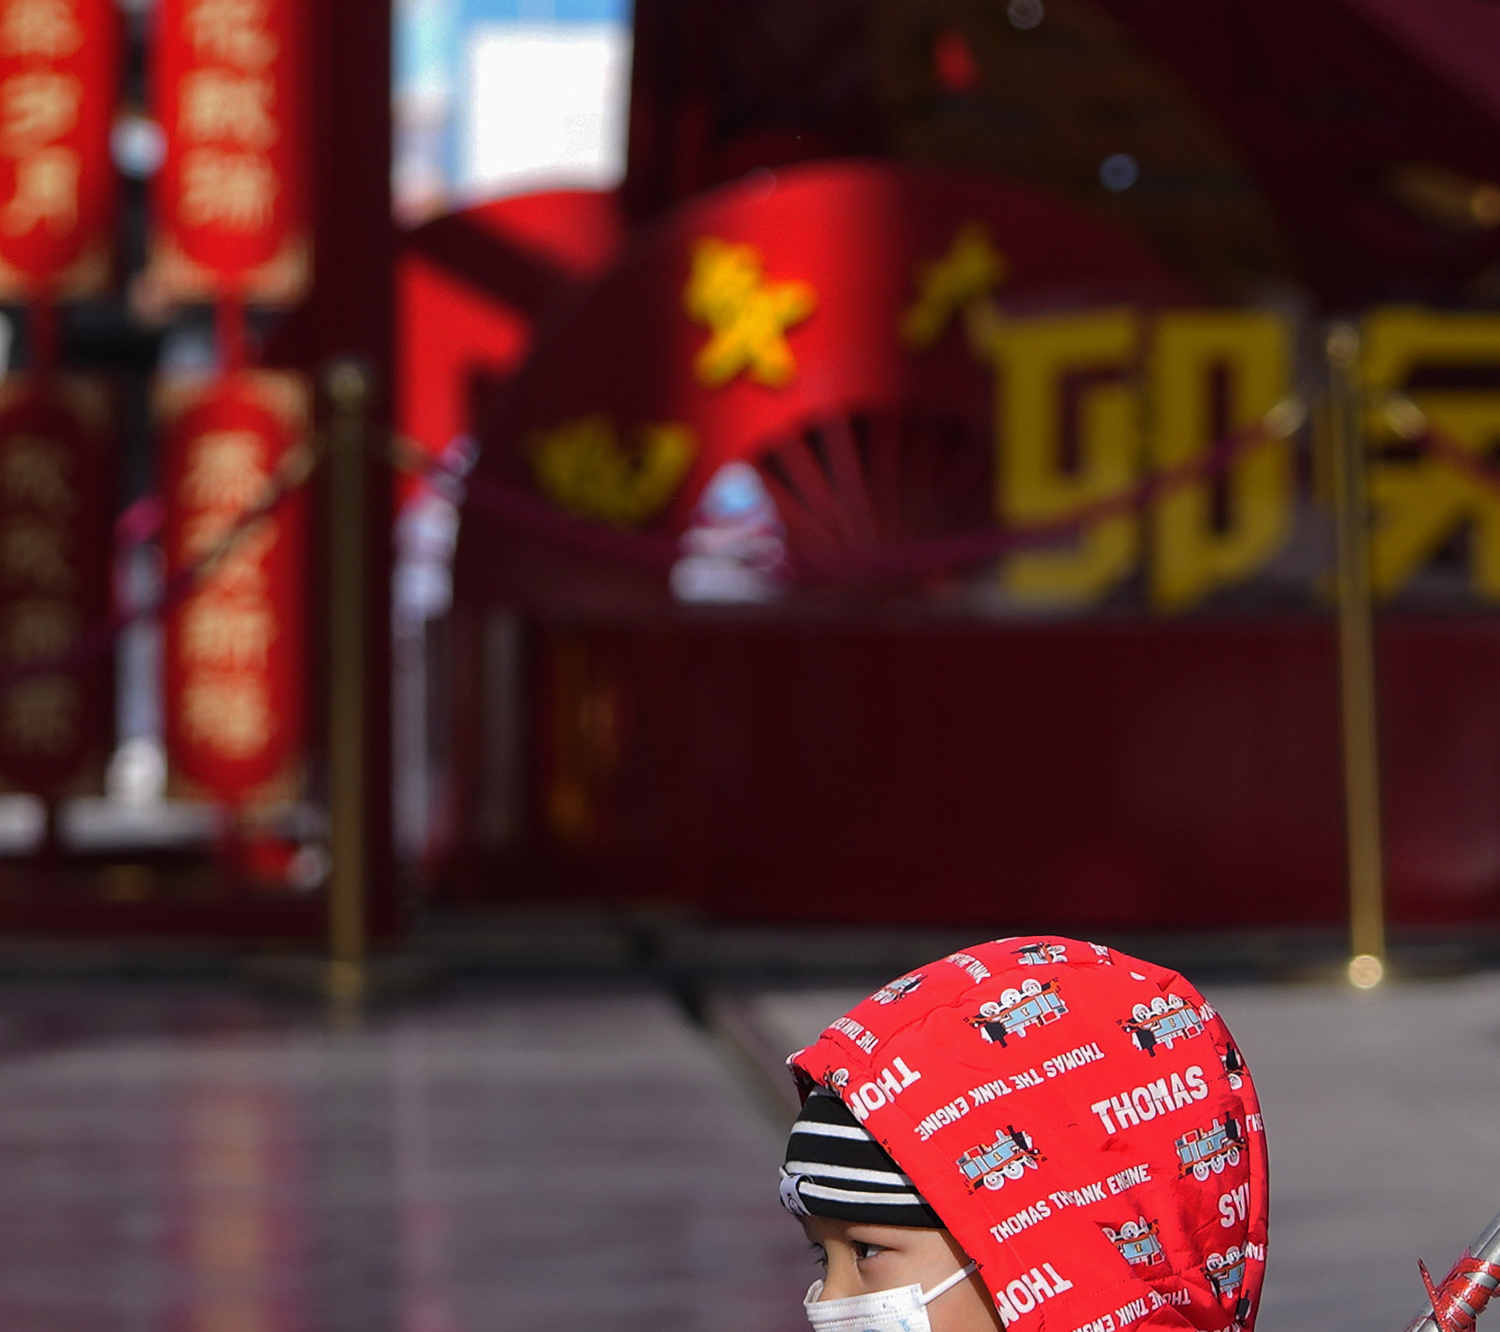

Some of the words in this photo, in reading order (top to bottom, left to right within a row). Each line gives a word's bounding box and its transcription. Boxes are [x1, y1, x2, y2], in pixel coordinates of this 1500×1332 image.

[1042, 1041, 1105, 1079] THOMAS
[967, 1079, 1012, 1108] TANK
[1008, 1068, 1045, 1091] THE
[913, 1095, 971, 1143] ENGINE
[1090, 1065, 1209, 1136] THOMAS
[989, 1199, 1052, 1244] THOMAS
[1118, 1298, 1150, 1327] TANK
